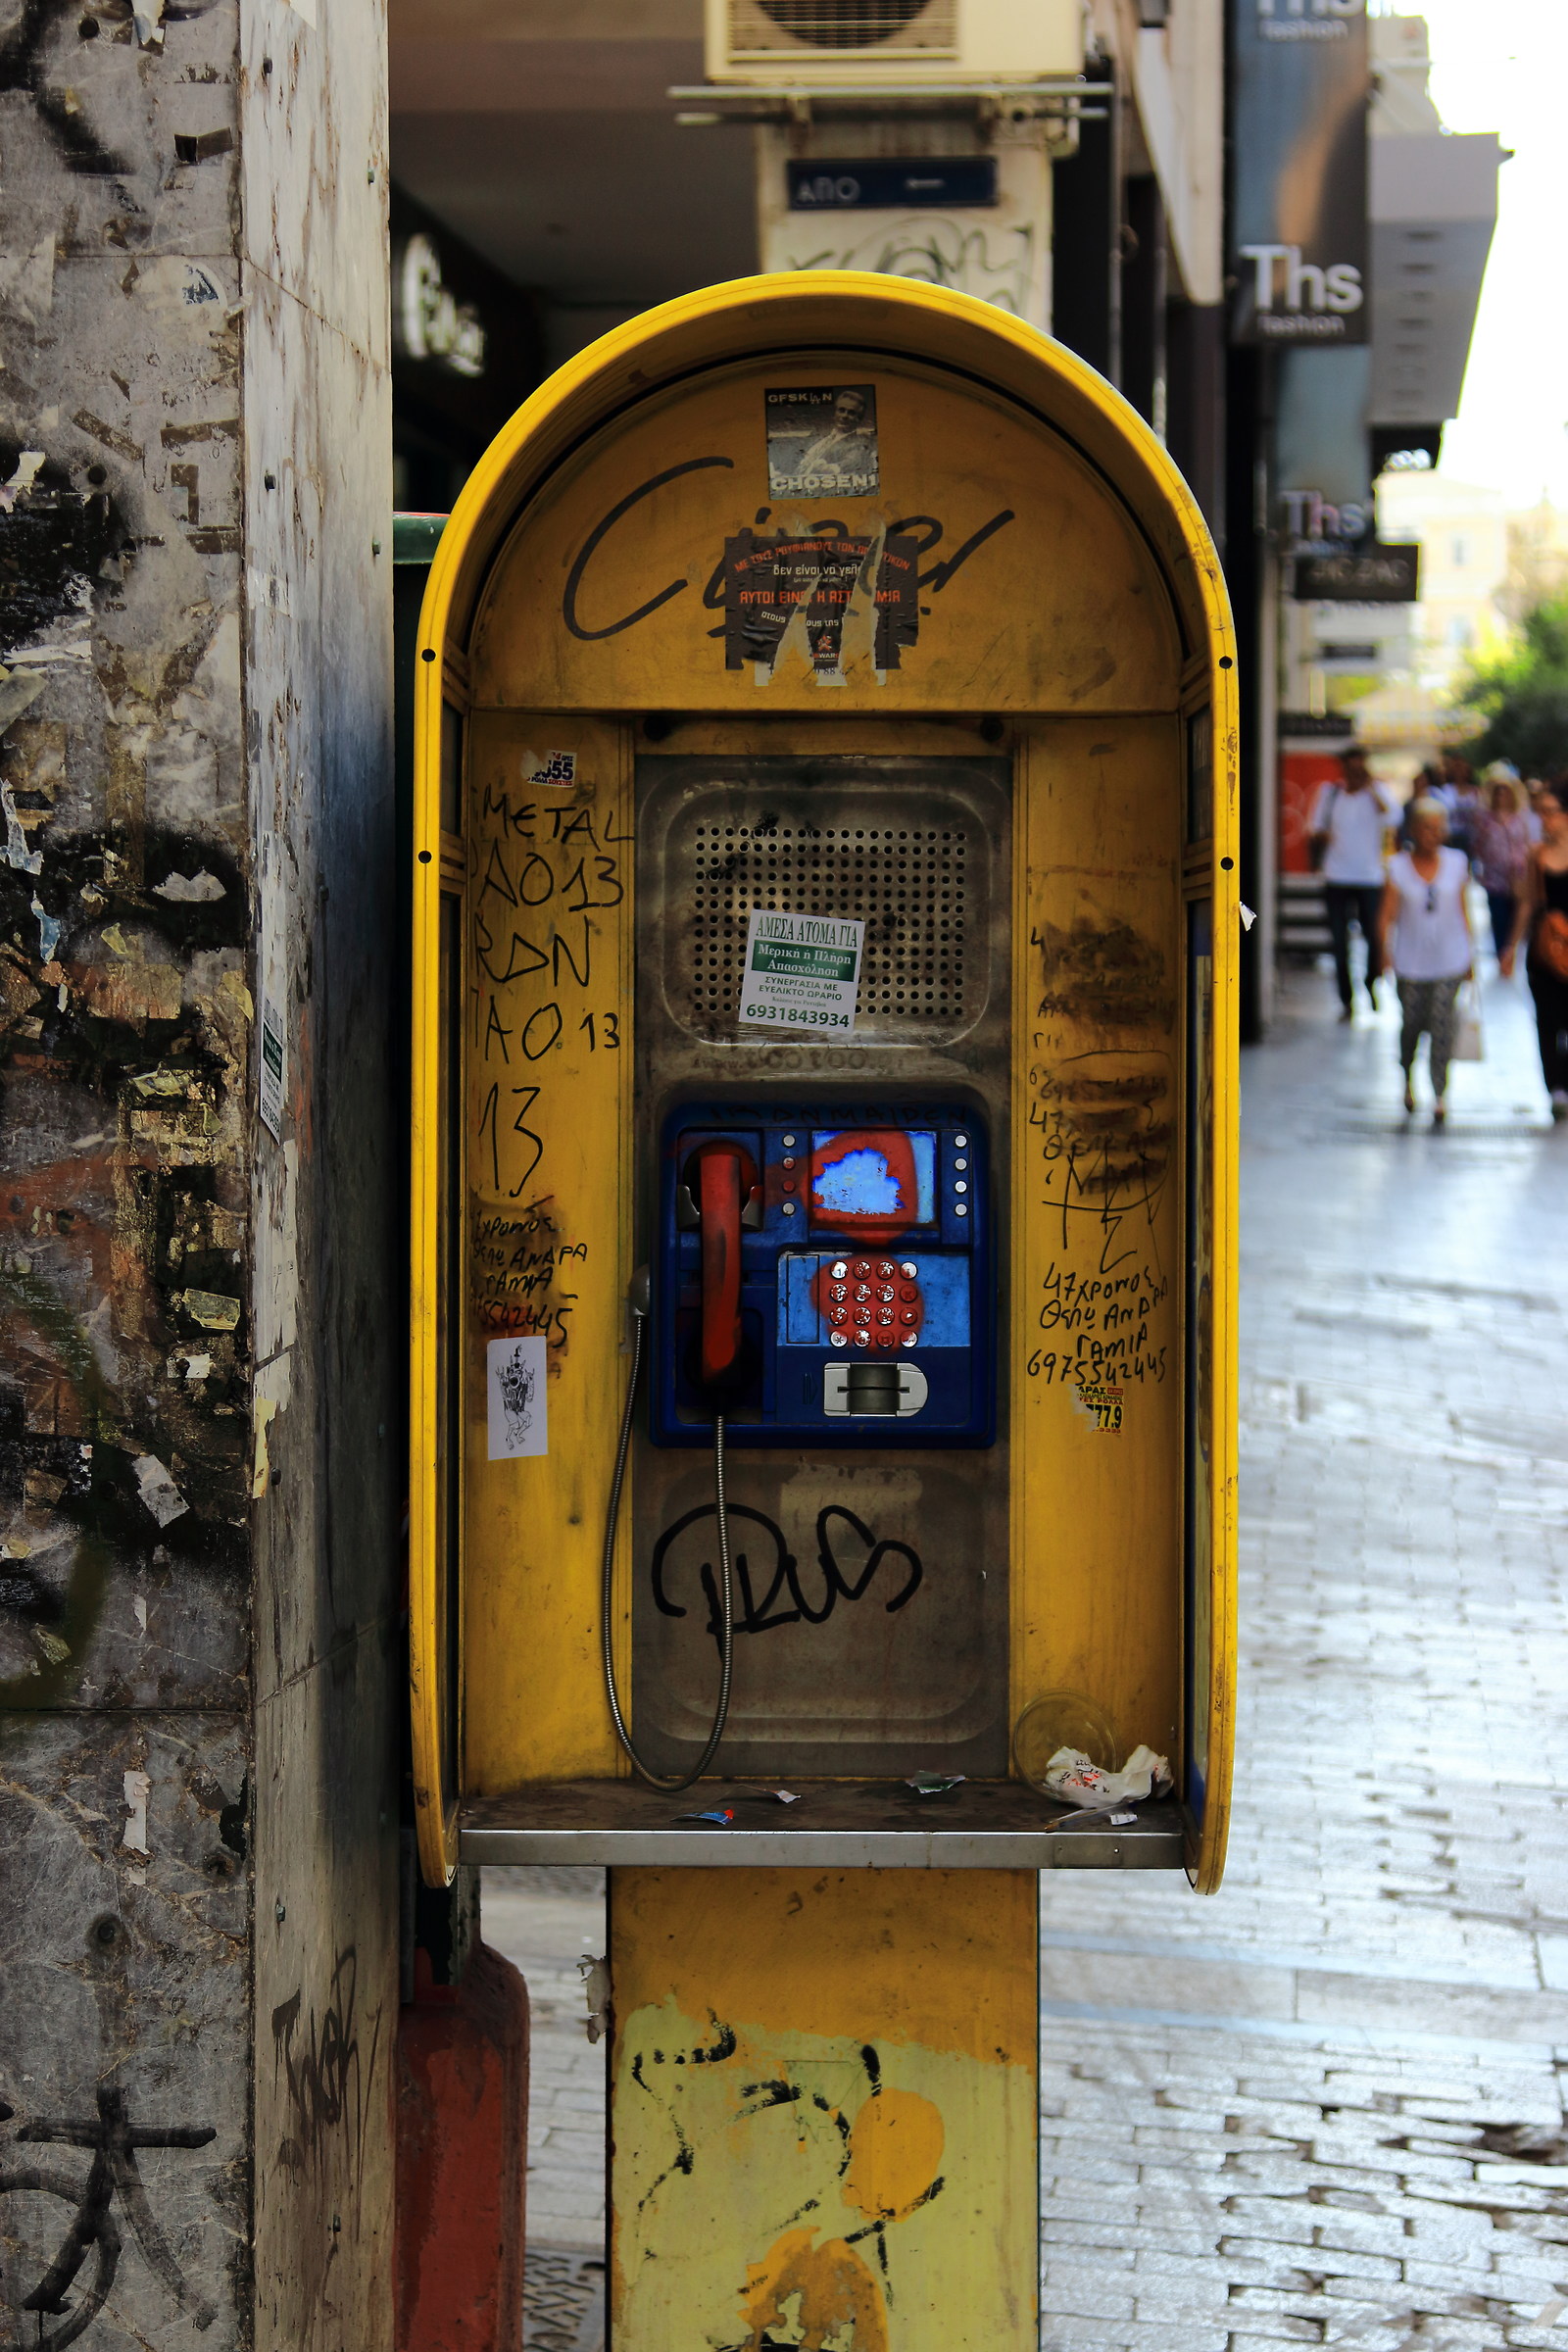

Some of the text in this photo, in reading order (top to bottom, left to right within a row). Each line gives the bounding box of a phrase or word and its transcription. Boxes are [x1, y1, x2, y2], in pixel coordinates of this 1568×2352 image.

[1239, 245, 1363, 312] Ths
[483, 783, 635, 853] METAL
[756, 915, 858, 948] ΑΜΕΣΑ ΑΤΟΜΑ ΓΙΑ
[758, 943, 800, 959] Μερική
[813, 949, 852, 964] Πλήρη
[766, 958, 839, 977] Απασχόληση
[759, 984, 843, 1002] ΕΥΕΛΙΚΤΟ ΩΡΑΡΙΟ
[764, 976, 839, 992] ΣΥΝΕΡΓΑΣΙΑ ΜΕ
[746, 1004, 850, 1028] 6931843934
